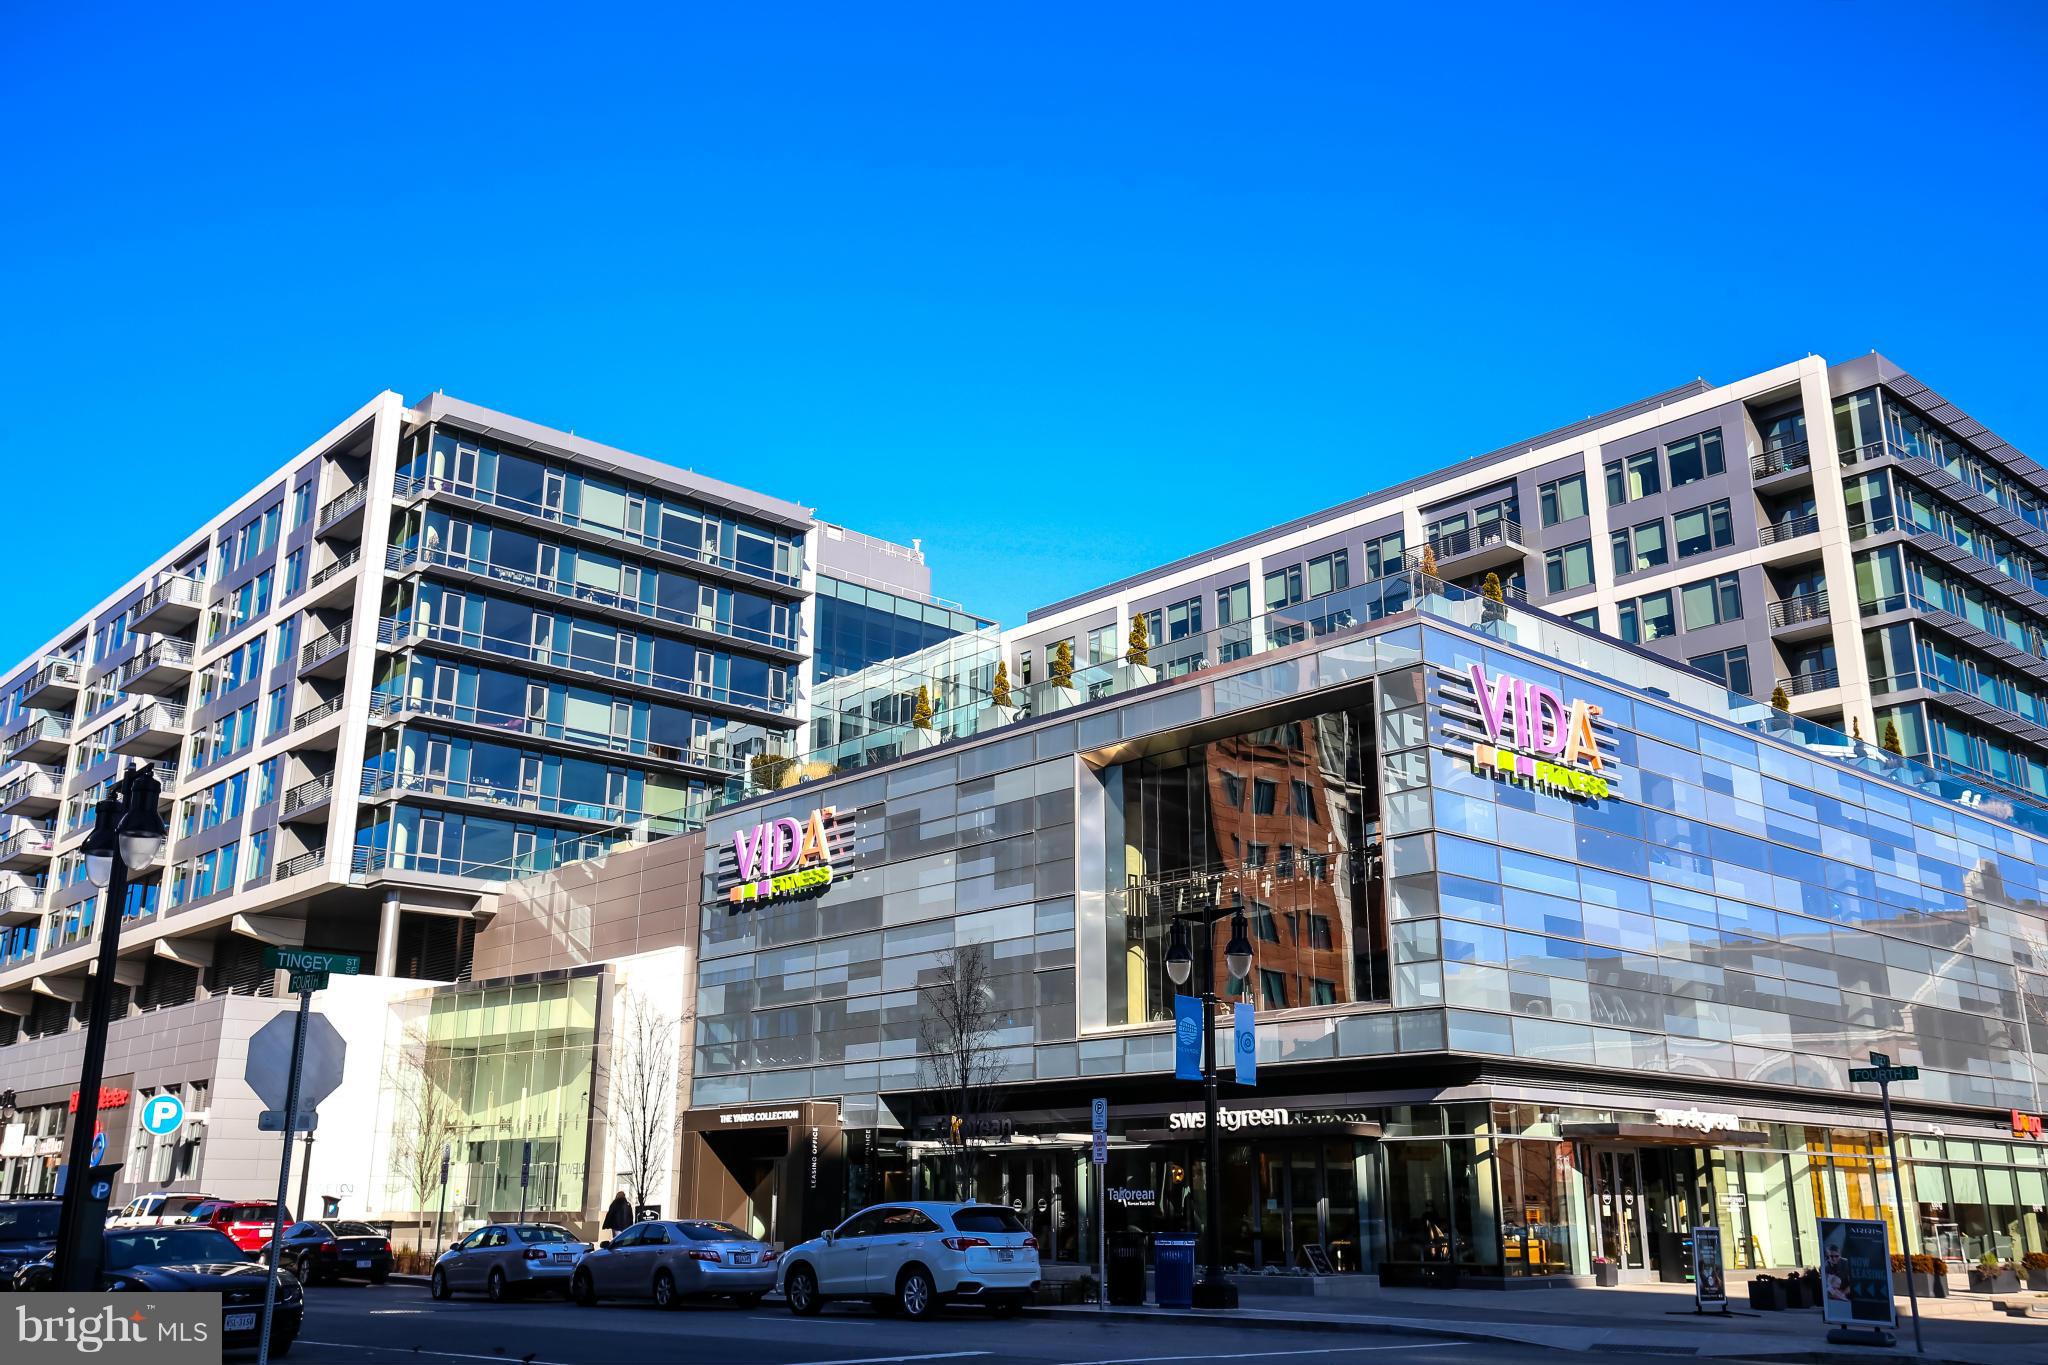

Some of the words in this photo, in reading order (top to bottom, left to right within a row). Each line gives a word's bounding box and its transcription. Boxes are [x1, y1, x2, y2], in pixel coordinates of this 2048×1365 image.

[1467, 663, 1603, 771] VIDA
[734, 808, 831, 881] VIDA
[278, 952, 333, 971] TINGEY
[346, 958, 357, 966] ST
[345, 966, 357, 974] SE
[291, 974, 320, 990] FOURTH
[1854, 1069, 1903, 1081] FOURTH
[152, 1102, 178, 1128] P
[720, 1115, 733, 1124] THE
[733, 1112, 754, 1123] YARDS
[755, 1110, 799, 1121] COLLECTION
[1169, 1107, 1289, 1132] swetgreen
